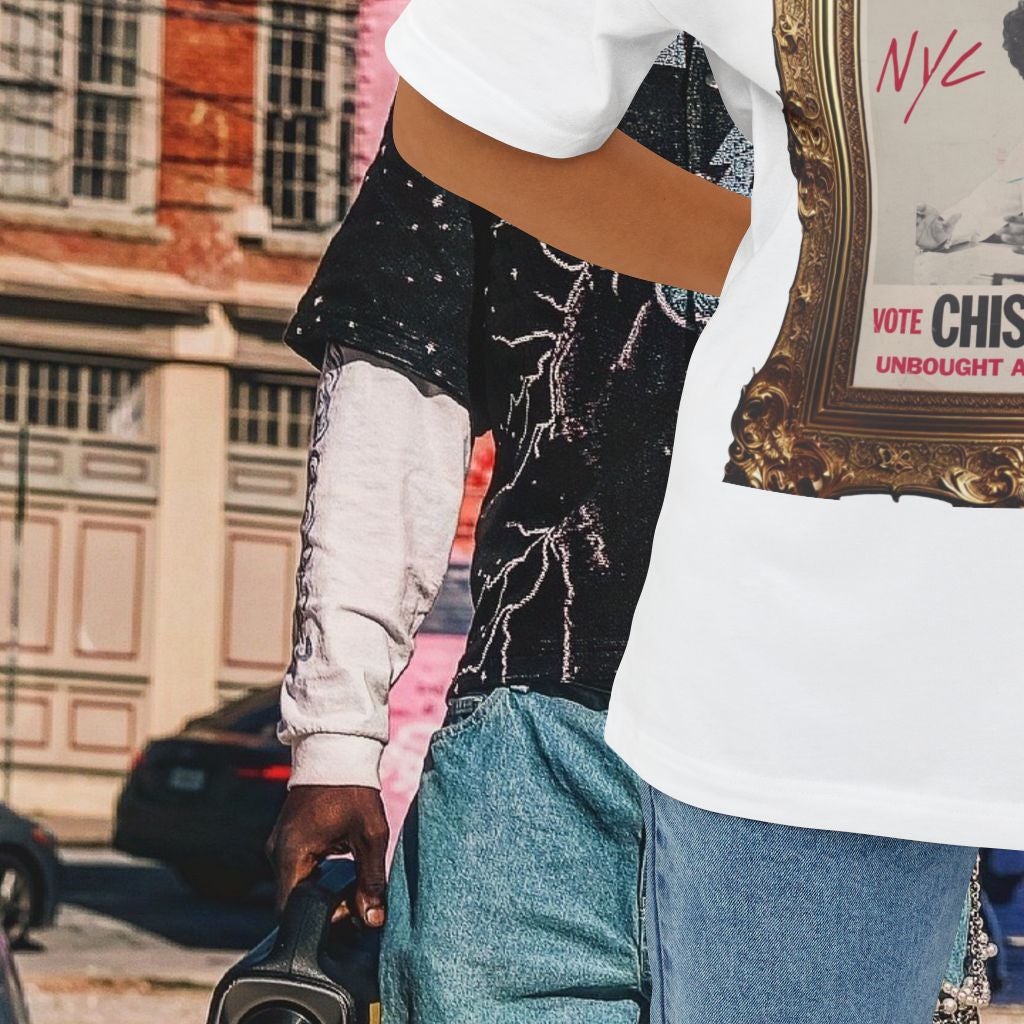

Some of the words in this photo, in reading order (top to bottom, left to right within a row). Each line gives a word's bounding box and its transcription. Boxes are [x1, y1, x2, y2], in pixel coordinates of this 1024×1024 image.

[876, 29, 986, 124] NYC
[873, 307, 924, 335] VOTE
[875, 355, 1004, 376] UNBOUGHT
